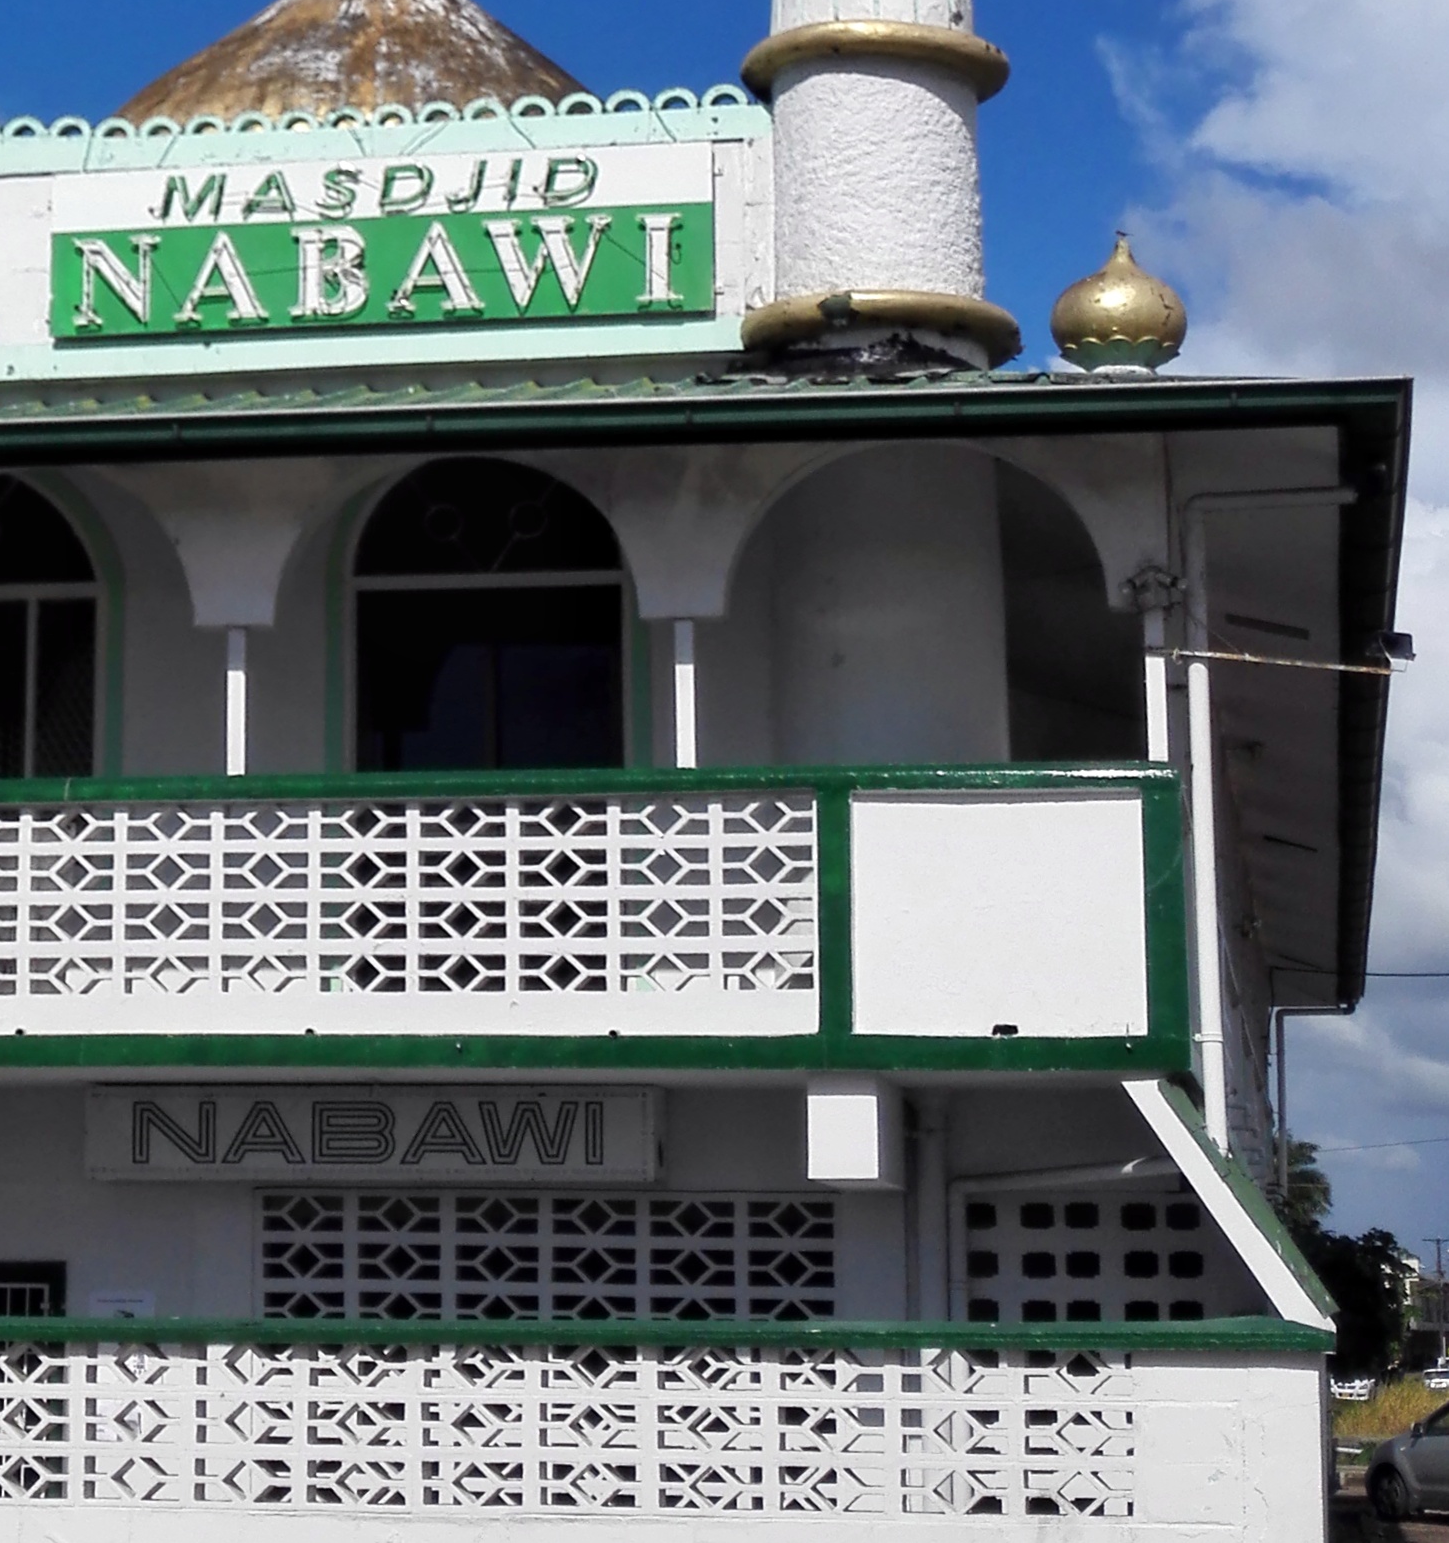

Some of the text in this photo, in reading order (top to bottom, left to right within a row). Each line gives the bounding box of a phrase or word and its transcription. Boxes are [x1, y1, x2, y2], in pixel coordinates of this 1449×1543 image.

[152, 157, 600, 222] MASDJID
[74, 213, 684, 329] NABAWI
[132, 1101, 605, 1165] NABAWI
